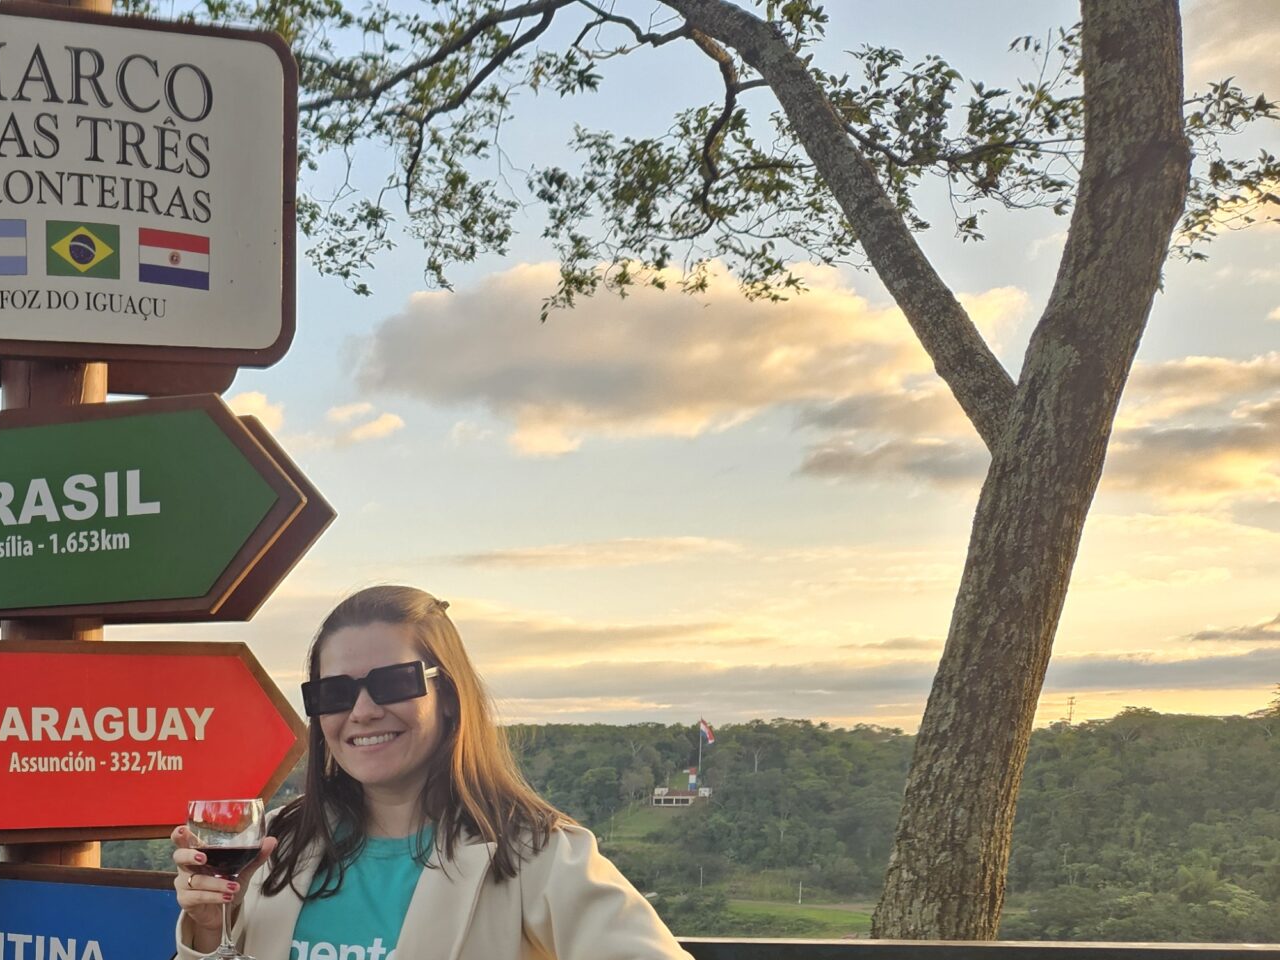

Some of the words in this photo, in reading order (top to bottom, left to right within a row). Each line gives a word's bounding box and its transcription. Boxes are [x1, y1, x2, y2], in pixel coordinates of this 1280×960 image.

[76, 116, 211, 179] TRÊS
[0, 289, 41, 309] FOZ
[46, 290, 79, 310] DO
[85, 291, 167, 321] IGUAÇU
[49, 528, 130, 554] 1.653km
[9, 751, 96, 773] Assunción
[110, 750, 183, 774] 332,7km
